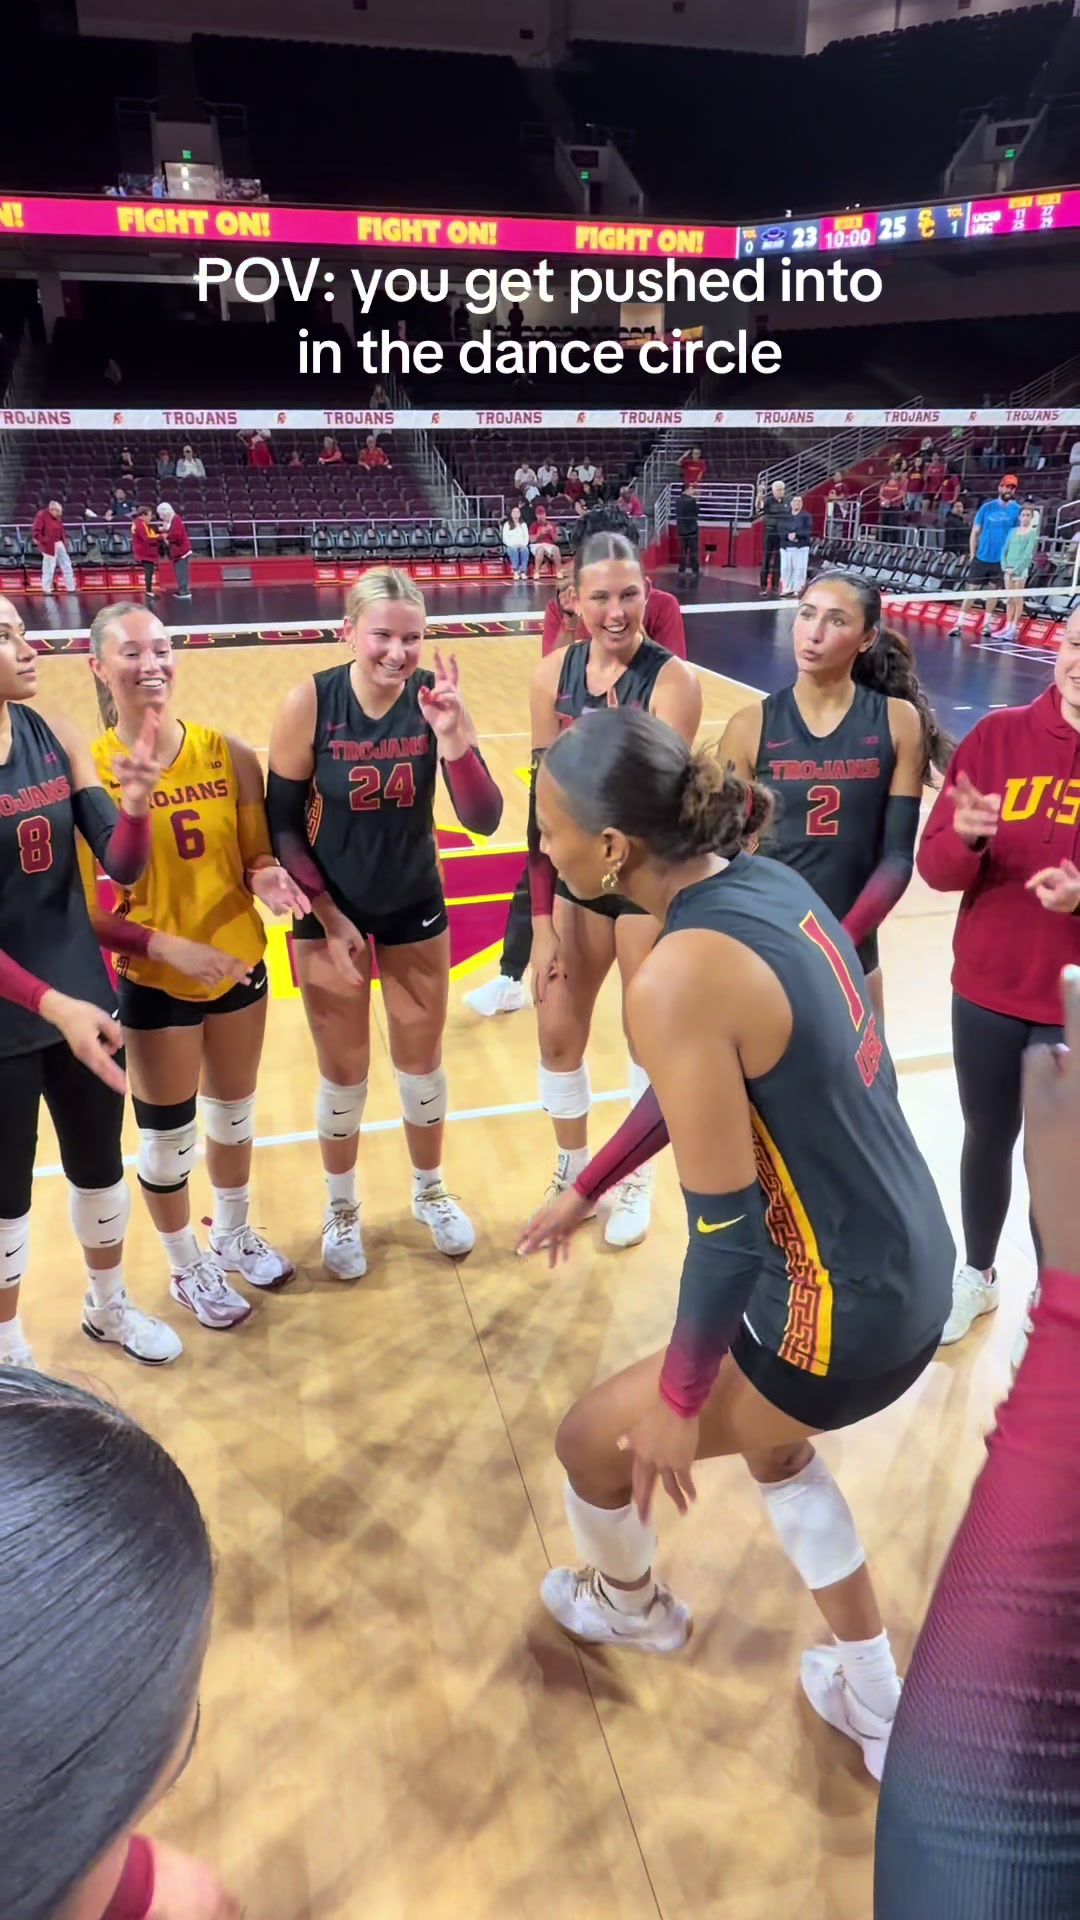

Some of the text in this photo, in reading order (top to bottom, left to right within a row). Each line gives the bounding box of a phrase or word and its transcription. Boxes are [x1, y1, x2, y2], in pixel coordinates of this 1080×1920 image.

[117, 206, 271, 238] FIGHT ON!
[357, 216, 497, 246] FIGHT ON!
[878, 216, 907, 241] 25
[951, 220, 958, 234] 1
[575, 225, 705, 254] FIGHT ON!
[745, 240, 754, 254] 0
[791, 226, 818, 249] 23
[824, 228, 871, 248] 10:00
[0, 411, 72, 425] ROJANS
[161, 411, 238, 425] TROJANS
[323, 411, 395, 425] TROJANS
[476, 412, 543, 425] TROJANS
[619, 412, 683, 424] TROJANS
[755, 411, 814, 424] TROJANS
[884, 411, 940, 423] TROJANS
[1005, 410, 1060, 421] TROJANS
[328, 734, 430, 761] TROJANS
[768, 758, 880, 780] TROJANS
[0, 775, 71, 817] OJANS
[148, 778, 229, 809] OJANS
[349, 762, 416, 811] 24
[806, 785, 840, 835] 2
[16, 815, 53, 874] 8
[170, 808, 206, 860] 6
[799, 909, 865, 1032] 1
